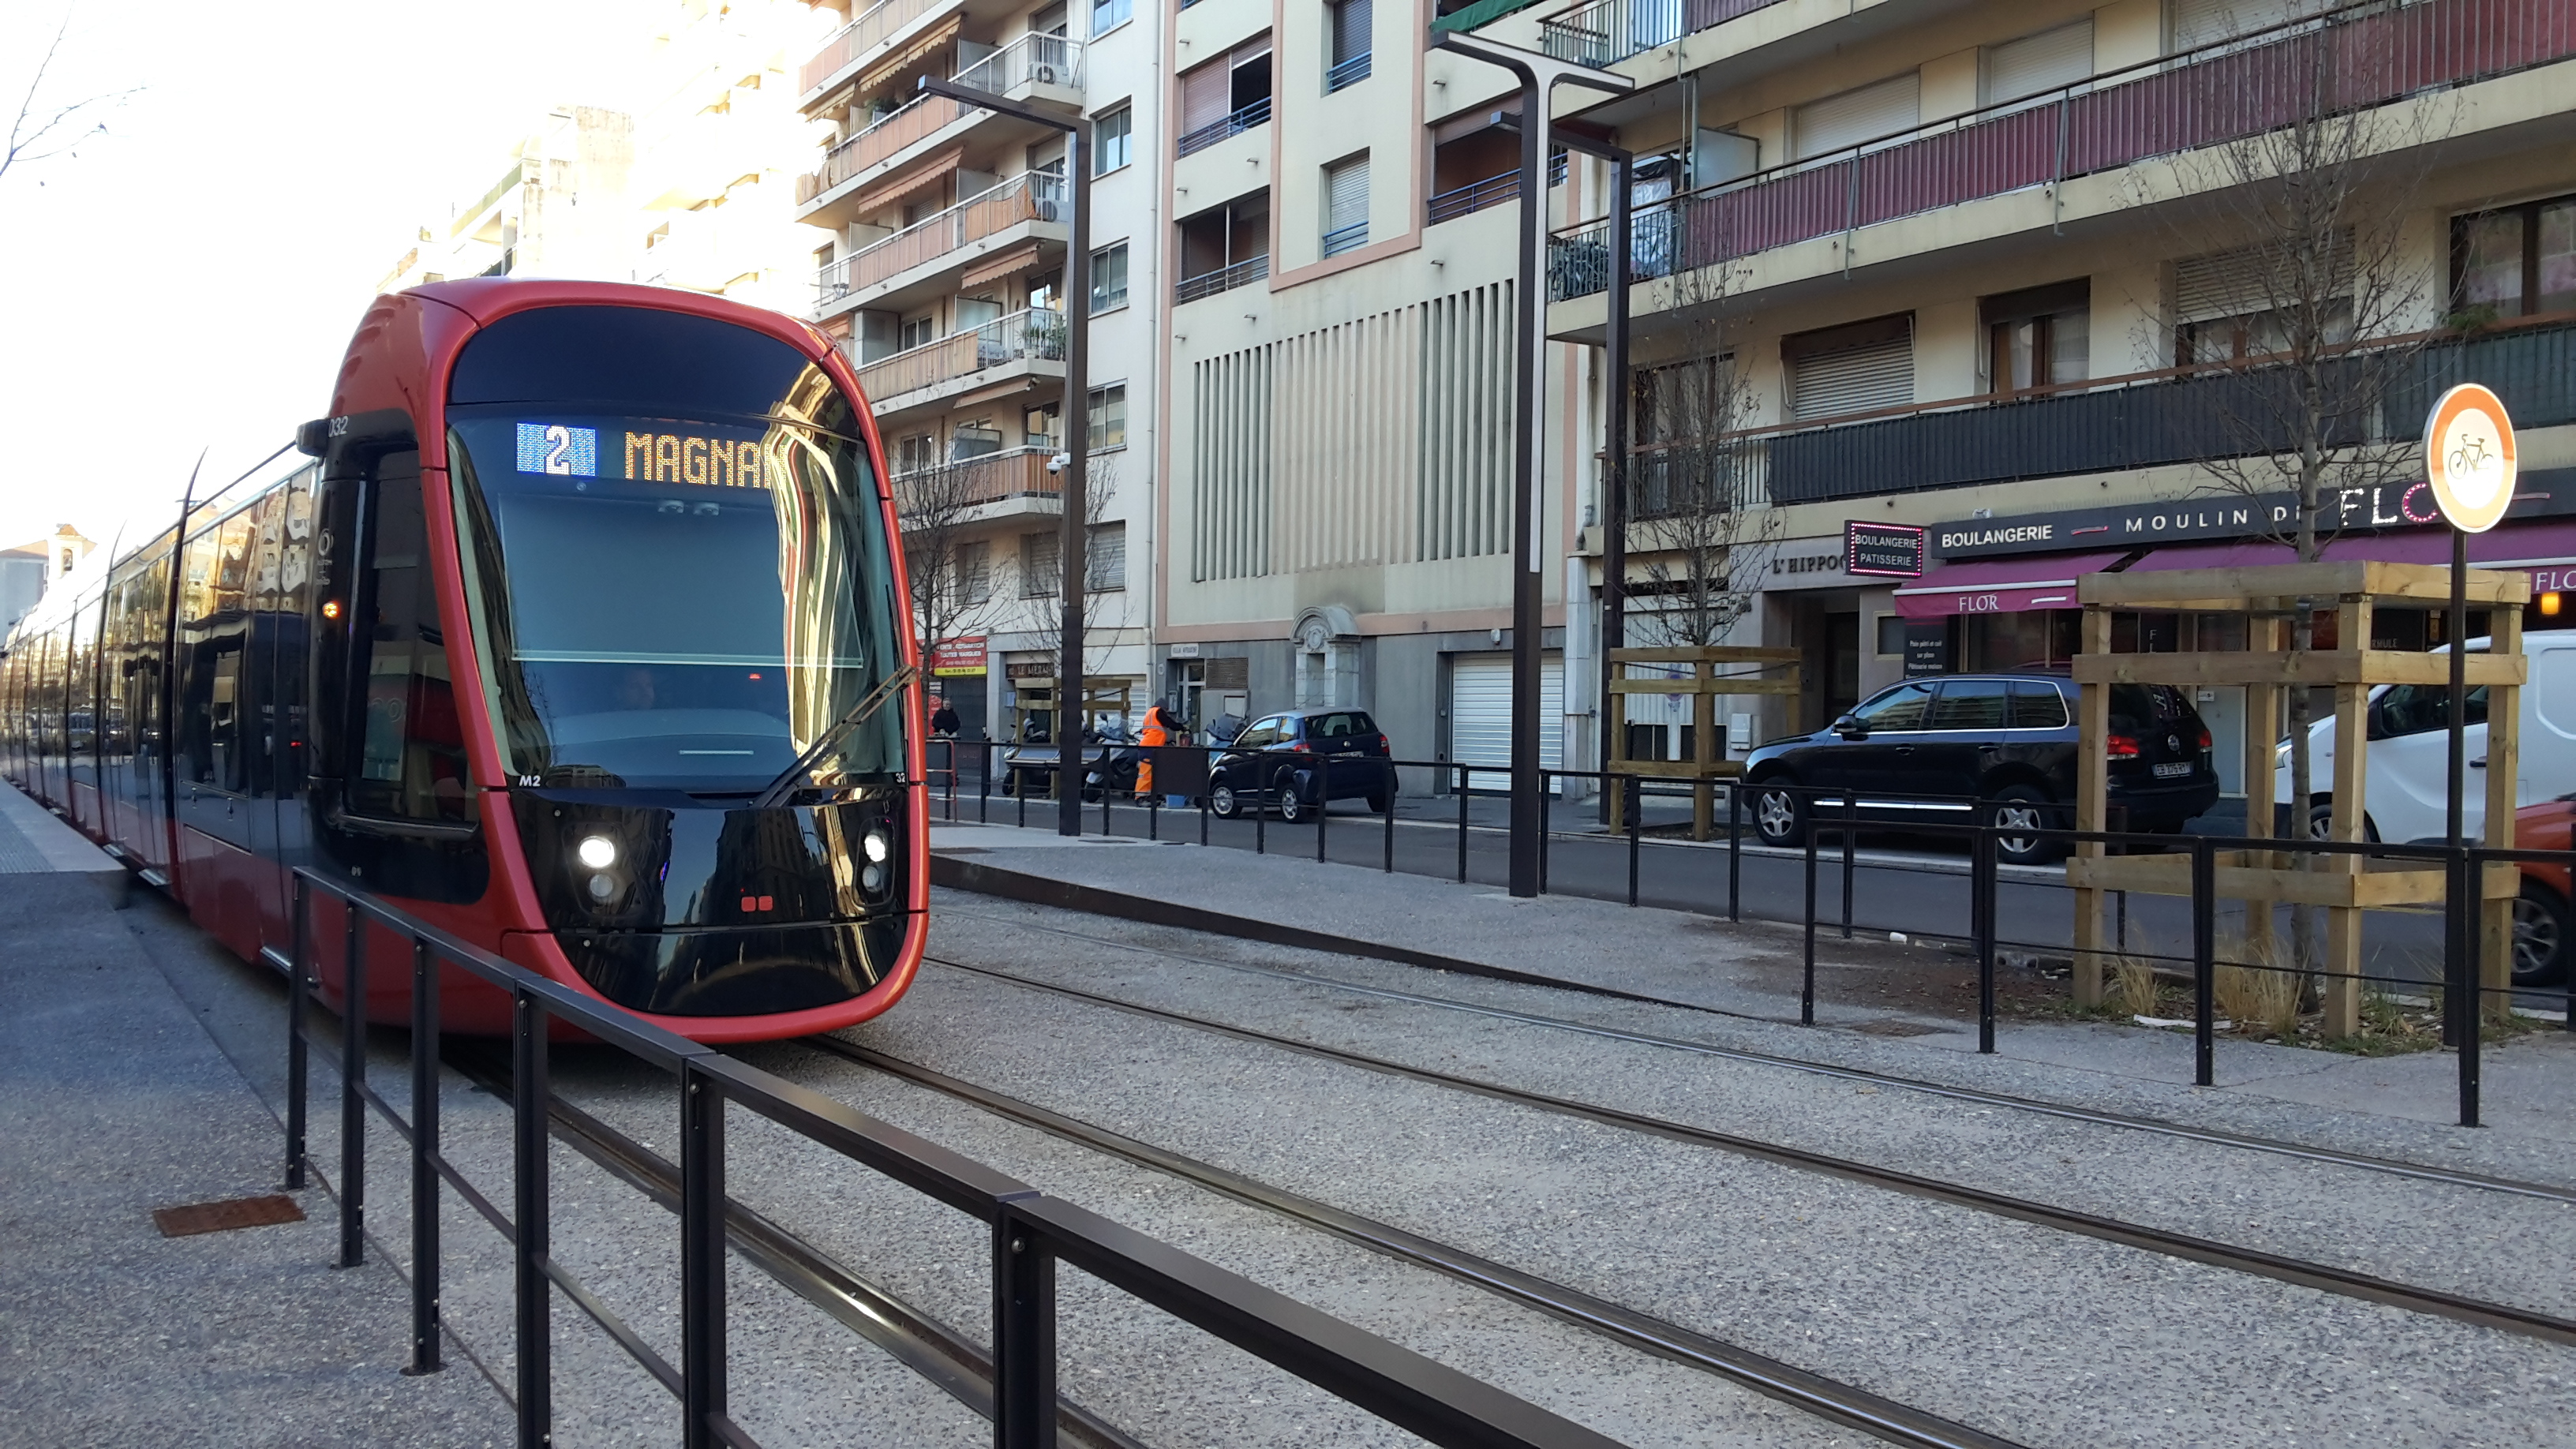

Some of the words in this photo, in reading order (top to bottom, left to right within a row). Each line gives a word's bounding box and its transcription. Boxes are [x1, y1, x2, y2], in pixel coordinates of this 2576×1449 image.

[328, 415, 349, 438] 032
[546, 425, 570, 475] 2
[2125, 508, 2248, 533] MOULIN
[2339, 482, 2438, 526] FLO
[1855, 534, 1918, 549] BOULANGERIE
[1941, 524, 2053, 549] BOULANGERIE
[1773, 555, 1845, 575] L'HIPPO
[1859, 552, 1912, 567] PATISSERIE
[1958, 593, 2000, 612] FLOR
[519, 774, 541, 787] M2
[895, 773, 906, 783] 32
